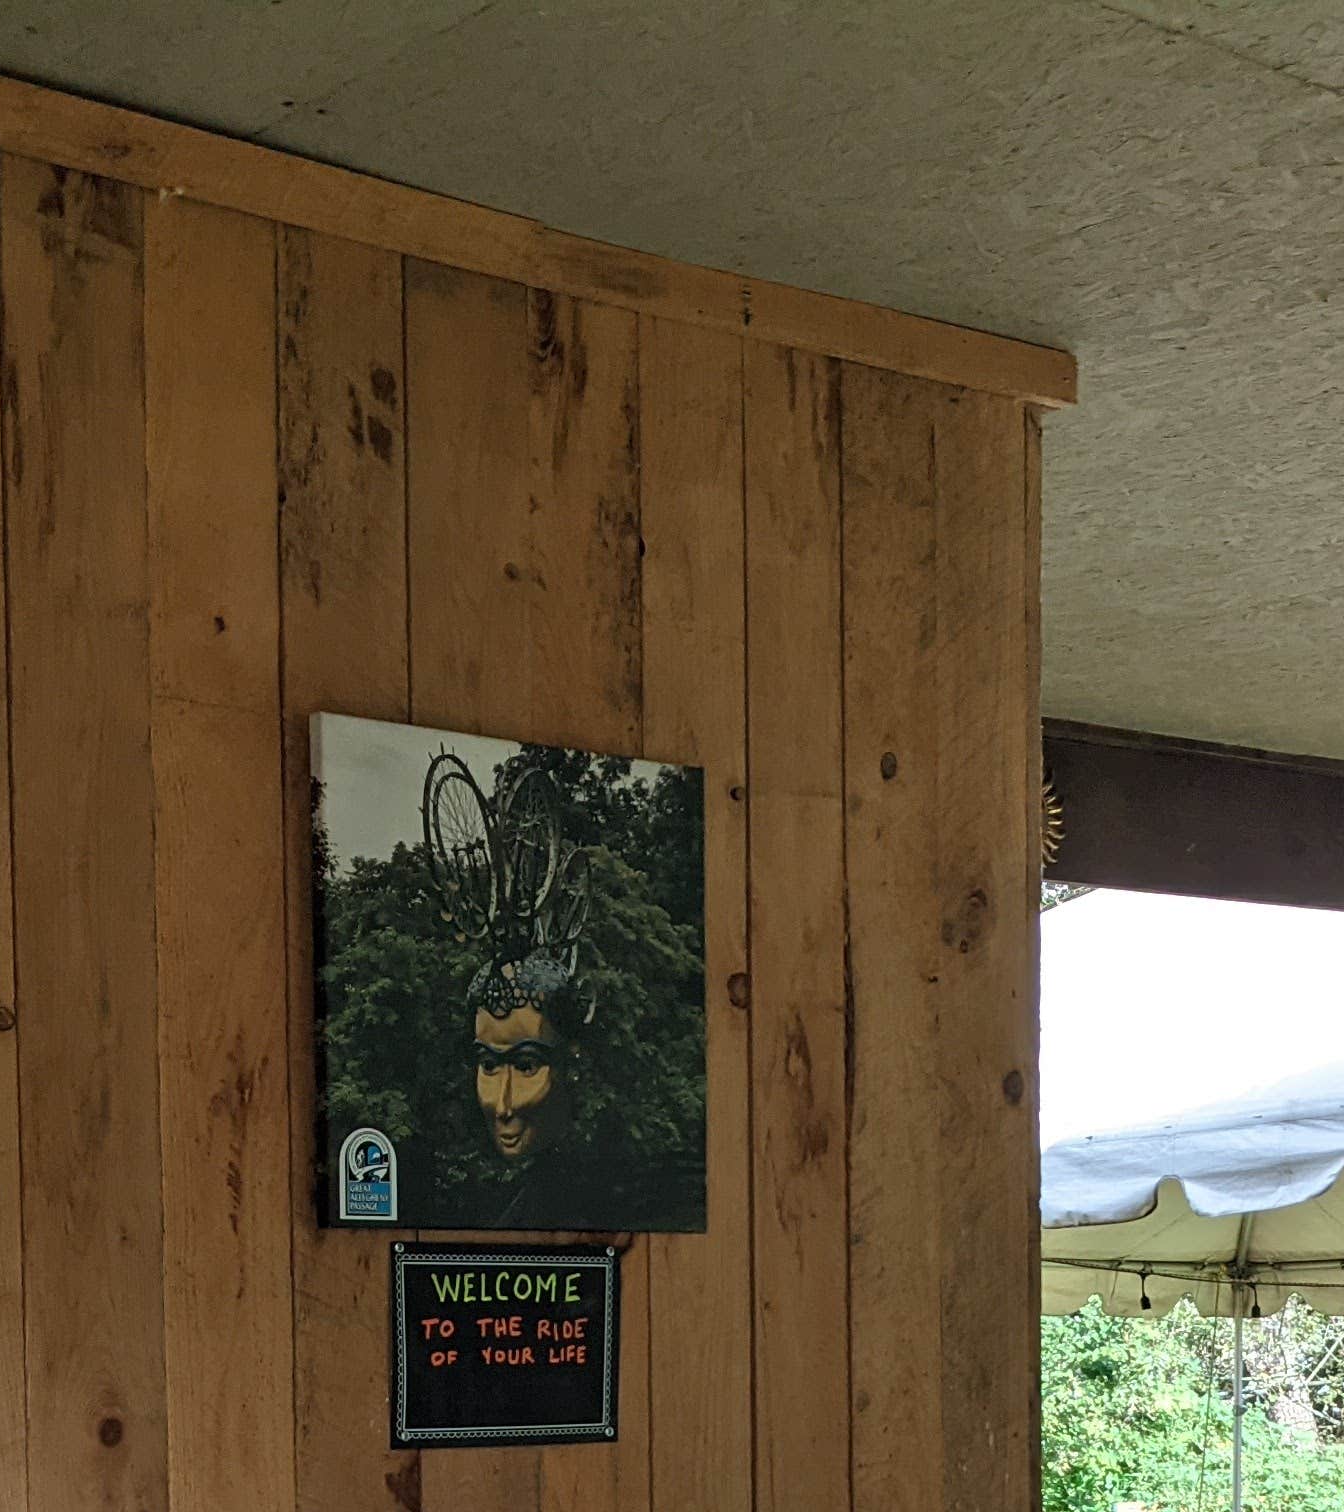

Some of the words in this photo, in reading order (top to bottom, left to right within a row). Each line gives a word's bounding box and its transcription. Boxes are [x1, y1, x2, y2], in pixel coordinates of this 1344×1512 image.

[430, 1272, 582, 1304] WELCOME
[421, 1317, 455, 1341] TO
[476, 1316, 523, 1339] THE
[537, 1317, 589, 1342] RIDE
[430, 1350, 458, 1367] OF
[482, 1347, 535, 1365] YOUR
[549, 1344, 587, 1365] LIFE
